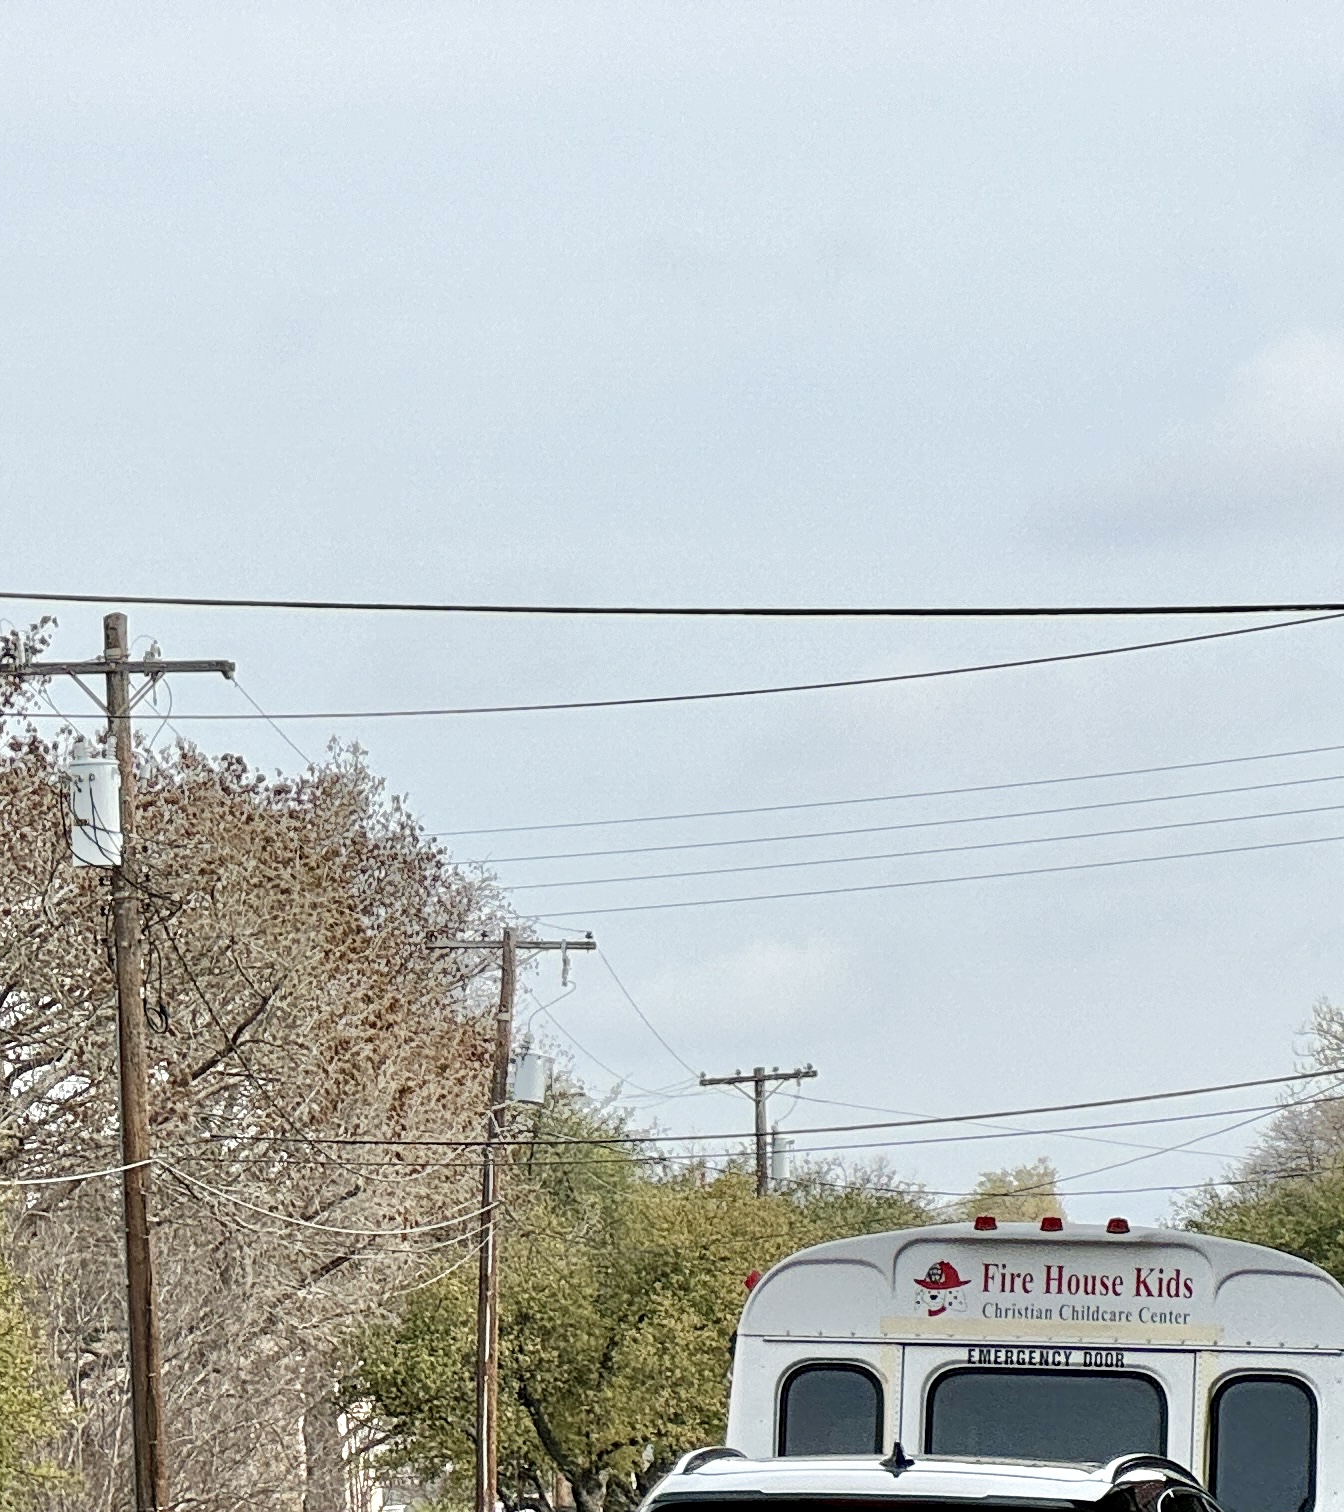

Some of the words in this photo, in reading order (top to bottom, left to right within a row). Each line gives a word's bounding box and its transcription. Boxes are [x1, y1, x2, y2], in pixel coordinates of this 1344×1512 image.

[982, 1262, 1034, 1294] Fire
[1043, 1264, 1124, 1297] House
[1132, 1267, 1194, 1299] Kids
[981, 1302, 1053, 1321] Christian
[1059, 1304, 1133, 1323] Childcare
[1138, 1306, 1191, 1325] Center
[967, 1348, 1073, 1367] EMERGENCY
[1083, 1351, 1126, 1368] DOOR
